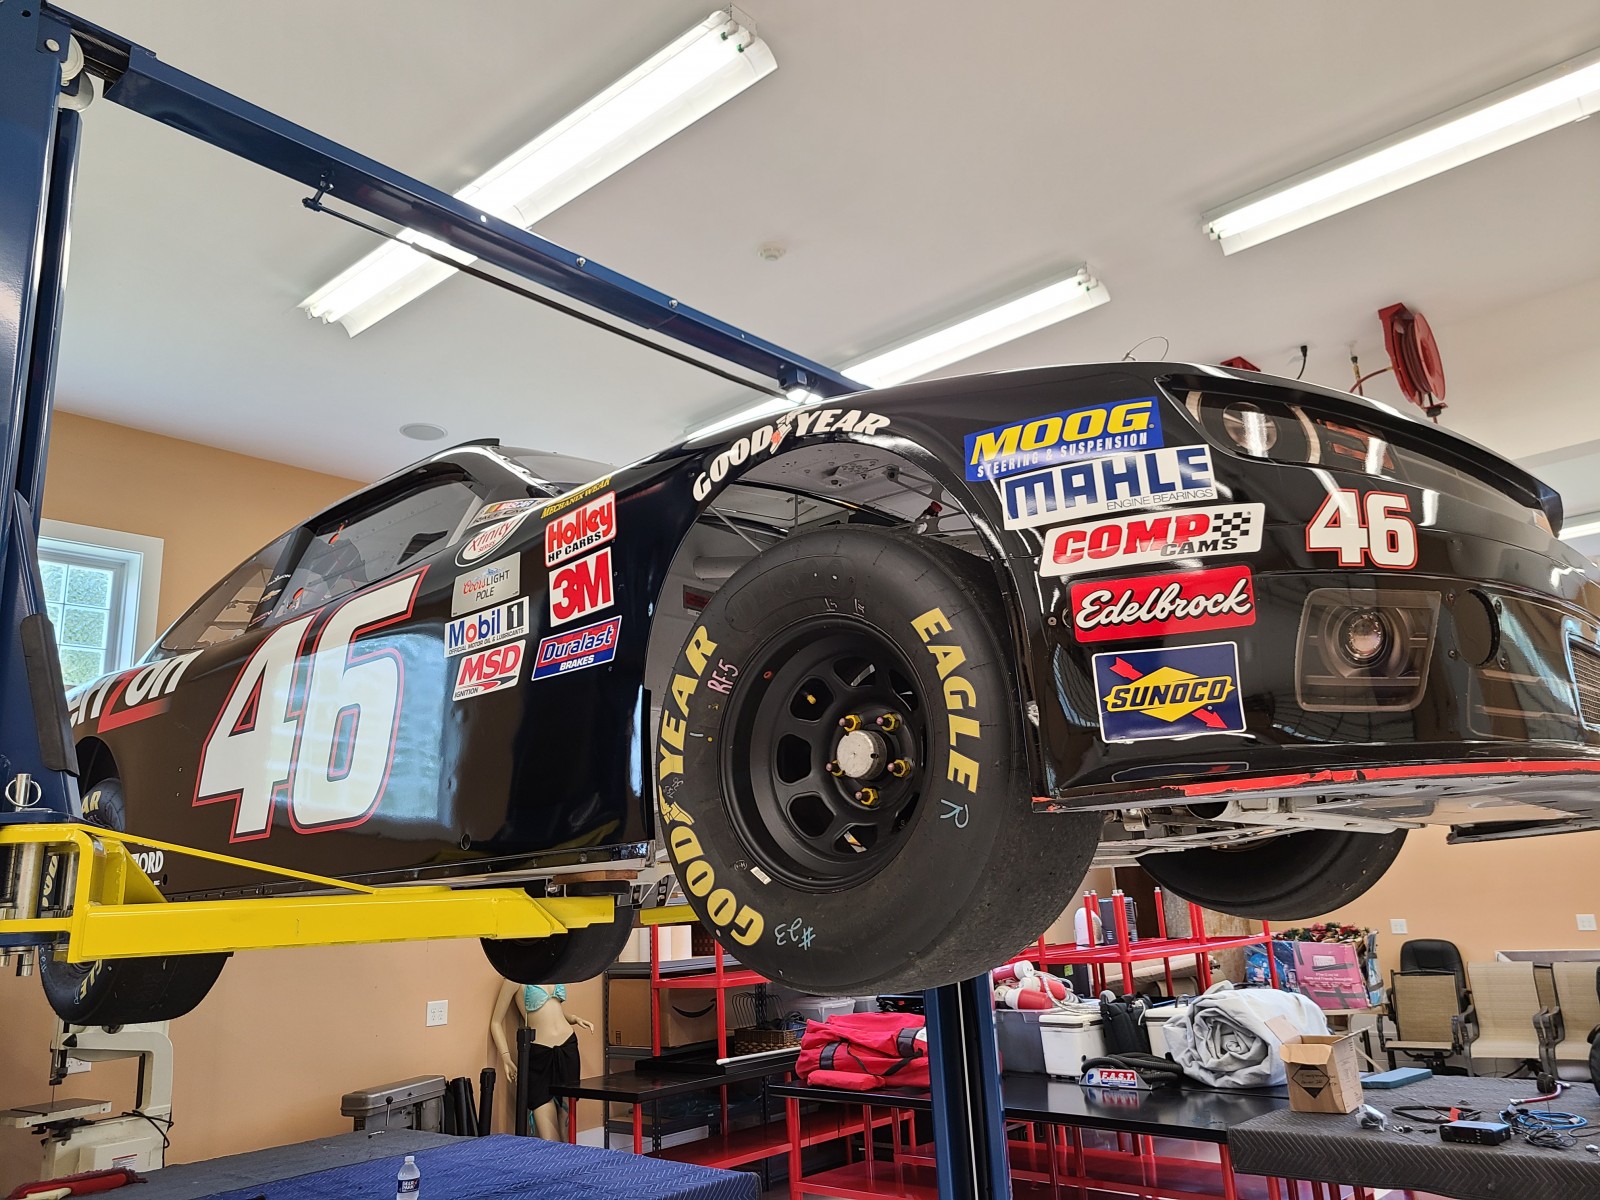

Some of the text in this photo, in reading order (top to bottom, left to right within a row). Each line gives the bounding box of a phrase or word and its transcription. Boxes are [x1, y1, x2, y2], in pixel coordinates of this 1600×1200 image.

[970, 401, 1153, 466] MOOG
[977, 432, 1148, 478] STEERING & SUSPENSION
[1006, 448, 1213, 520] MAHLE
[1107, 488, 1213, 511] ENGINE BEARINGS
[548, 501, 613, 553] Holley
[548, 531, 601, 563] HP CARBS
[1052, 513, 1210, 565] COMP
[1160, 537, 1238, 557] CAMS
[1306, 488, 1418, 569] 46
[476, 587, 495, 601] POLE
[552, 551, 612, 619] 3M
[1075, 578, 1251, 629] Edelbrock
[448, 646, 467, 656] OFFICIAL
[468, 640, 484, 650] MOTOR
[496, 627, 524, 641] LUBRICANTS
[449, 608, 500, 649] Mobil
[540, 624, 614, 663] Duralast
[458, 644, 520, 686] MSD
[559, 654, 595, 672] BRAKES
[192, 564, 430, 843] 46
[454, 686, 479, 699] IGNITION
[910, 607, 981, 794] EAGLE
[1109, 679, 1230, 709] SUNOCO
